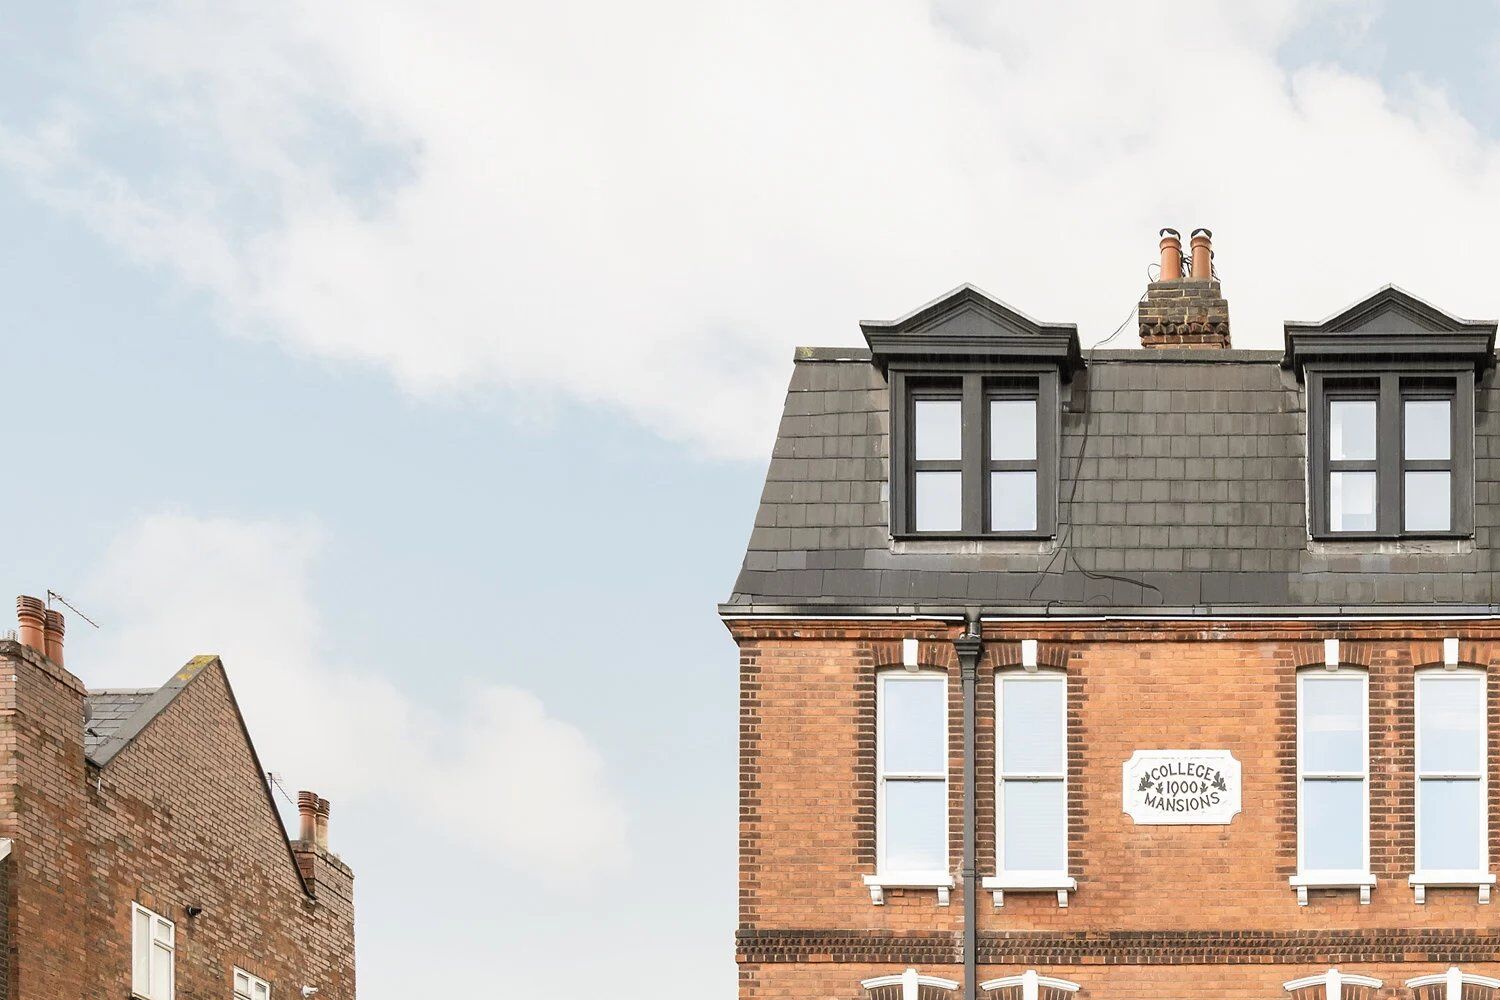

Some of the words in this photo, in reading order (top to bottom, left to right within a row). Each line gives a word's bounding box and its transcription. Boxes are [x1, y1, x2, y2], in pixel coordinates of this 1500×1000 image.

[1151, 762, 1214, 781] COLLEGE
[1167, 780, 1198, 797] 1900
[1144, 792, 1220, 812] MANSIONS
